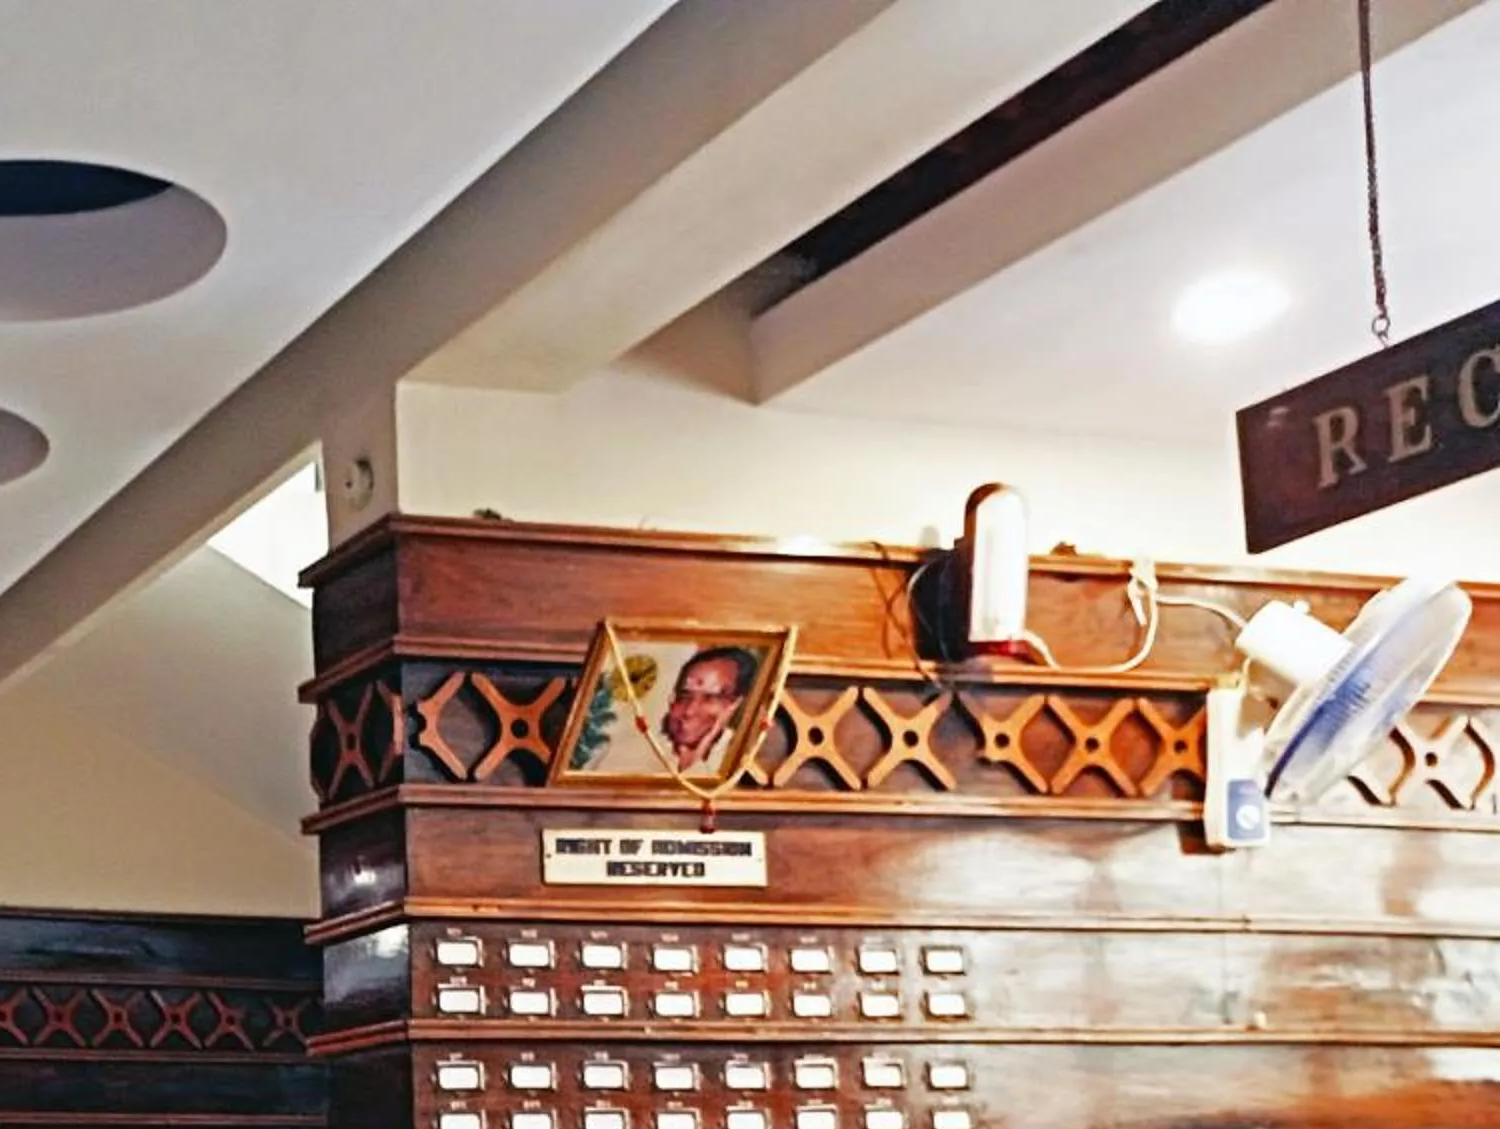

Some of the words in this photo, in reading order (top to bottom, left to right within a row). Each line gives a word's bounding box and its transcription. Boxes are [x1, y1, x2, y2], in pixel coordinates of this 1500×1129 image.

[1312, 344, 1500, 489] REC
[555, 838, 612, 855] RIGHT
[619, 839, 644, 856] OF
[651, 840, 753, 857] ADMISSION
[606, 861, 706, 878] RESERVED
